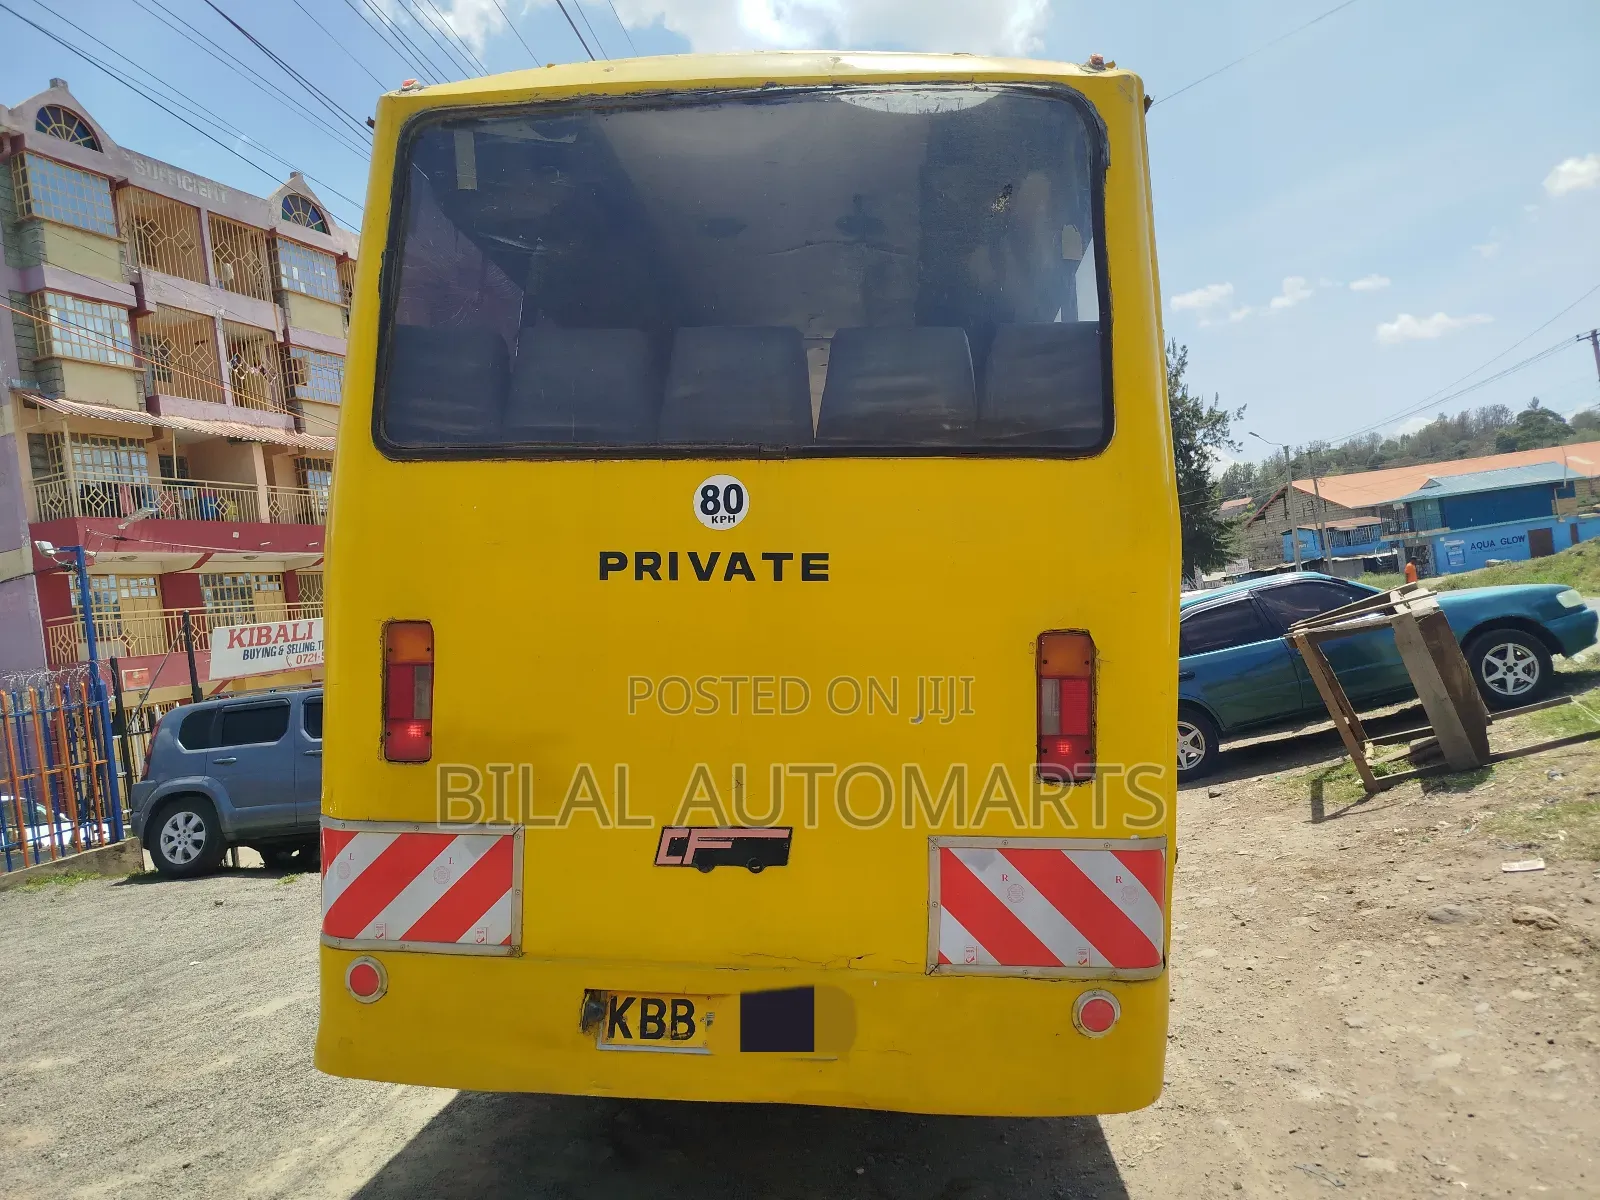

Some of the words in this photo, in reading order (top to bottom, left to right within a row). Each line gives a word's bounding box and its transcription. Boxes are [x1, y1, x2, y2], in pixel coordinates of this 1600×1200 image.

[134, 159, 229, 204] SUFFICIENT
[700, 483, 744, 515] 80
[711, 515, 736, 524] KPH
[1470, 540, 1496, 550] AQUA
[1500, 535, 1526, 545] GLOW
[599, 551, 829, 581] PRIVATE
[227, 621, 314, 649] KIBALI
[243, 646, 277, 660] BUYING
[278, 645, 284, 656] &
[1115, 876, 1122, 884] R
[607, 996, 696, 1040] KBB
